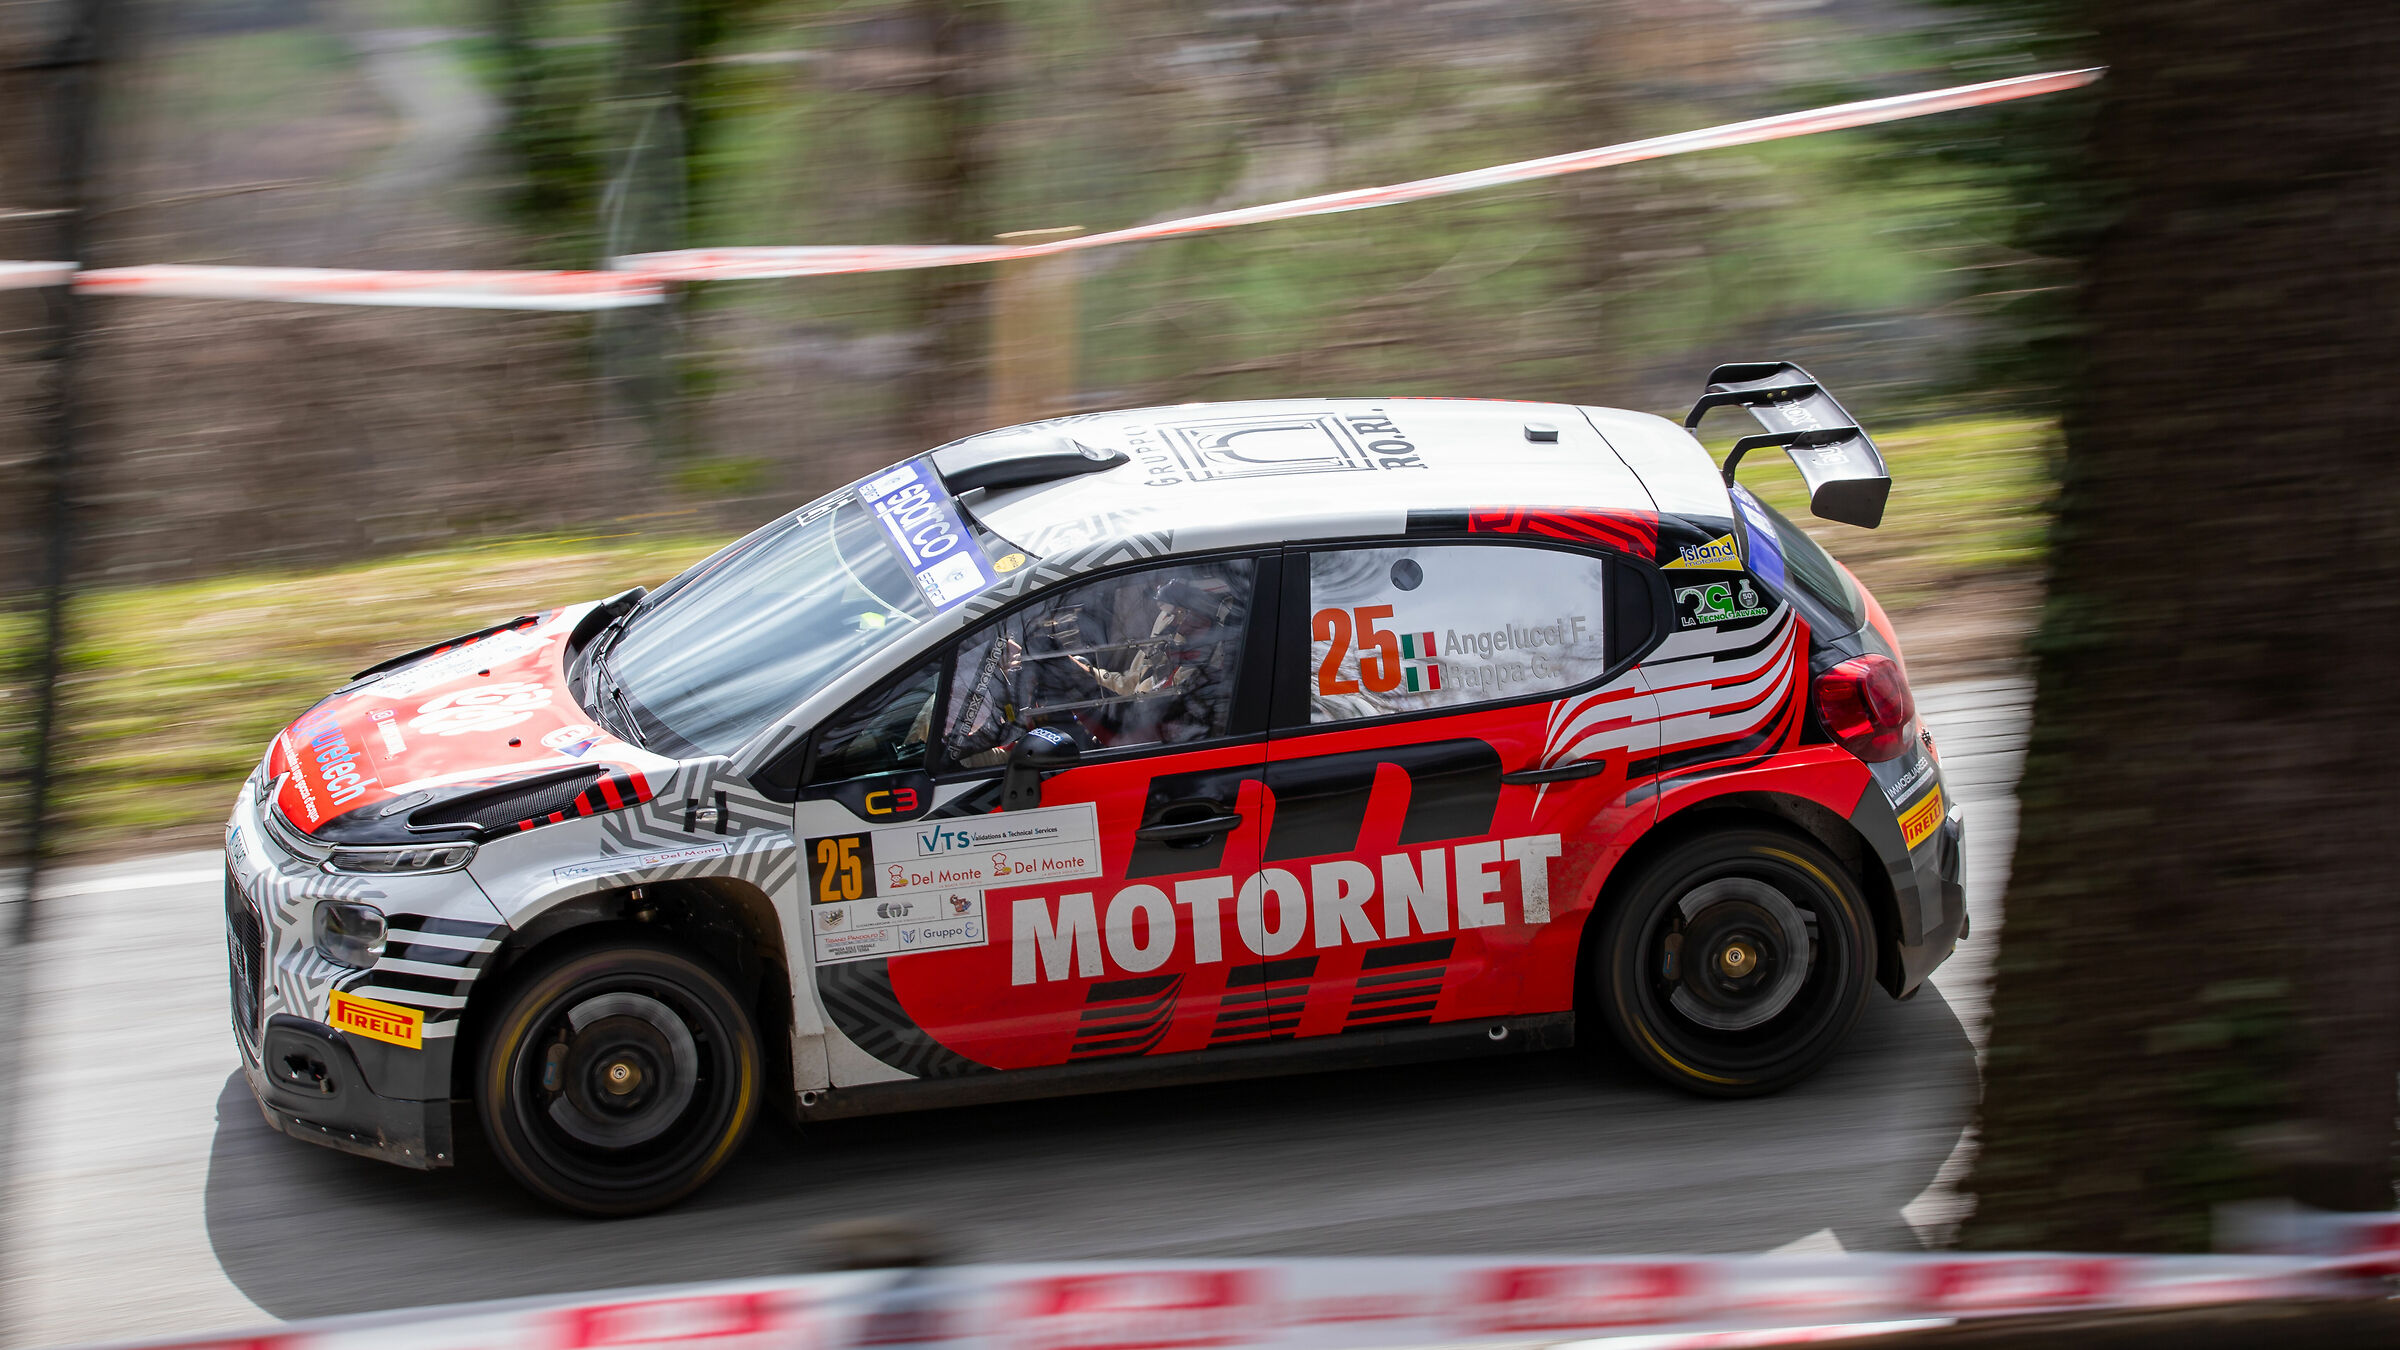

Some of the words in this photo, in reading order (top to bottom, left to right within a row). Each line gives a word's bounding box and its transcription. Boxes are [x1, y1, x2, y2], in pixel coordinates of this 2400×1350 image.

[1121, 425, 1183, 487] GRUPPO
[877, 483, 959, 558] sparco
[1680, 542, 1735, 562] island
[1684, 555, 1737, 568] motorsport
[1681, 616, 1697, 627] LA
[1312, 604, 1402, 697] 25
[1444, 617, 1565, 660] Angelucci
[865, 787, 918, 815] C3
[1901, 794, 1941, 843] PIRELLI
[922, 825, 970, 852] VTS
[971, 831, 1001, 842] Validations
[1008, 829, 1033, 838] Technical
[1034, 827, 1058, 835] Services
[660, 852, 681, 861] Del
[684, 846, 723, 857] Monte
[1014, 859, 1037, 874] Del
[1041, 856, 1085, 871] Monte
[816, 837, 863, 902] 25
[911, 870, 934, 886] Del
[938, 868, 982, 883] Monte
[1011, 833, 1561, 986] MOTORNET
[923, 926, 963, 940] Gruppo
[337, 999, 414, 1040] PIRELLI
